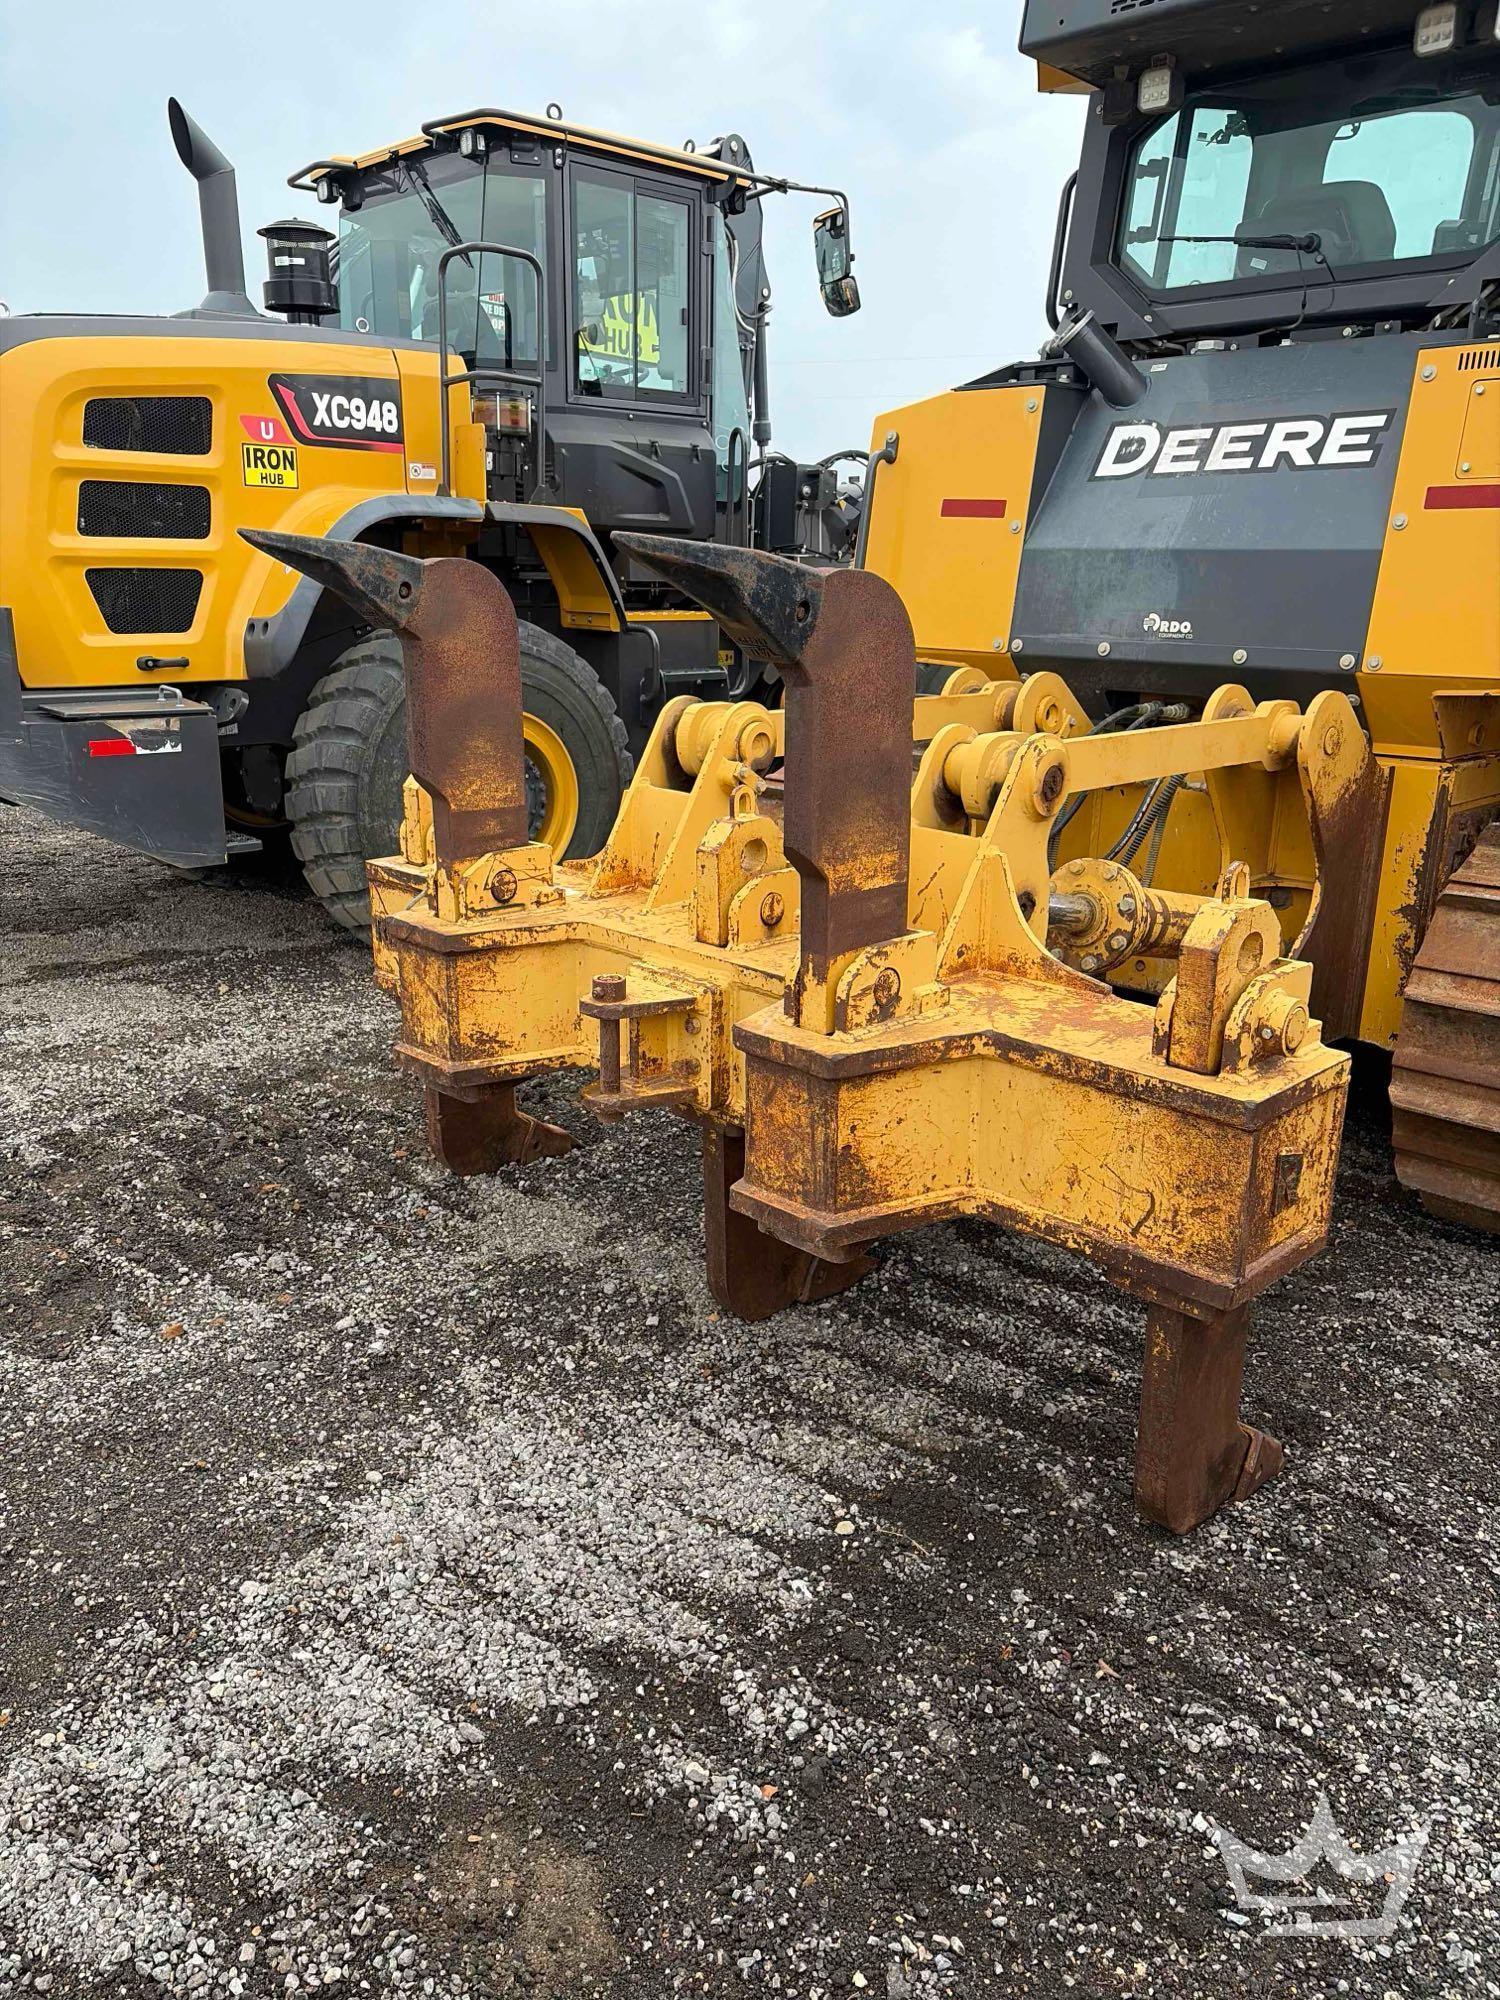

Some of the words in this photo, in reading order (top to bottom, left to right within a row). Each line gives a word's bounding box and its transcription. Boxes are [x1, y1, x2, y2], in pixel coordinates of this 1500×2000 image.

[311, 392, 399, 434] XC948
[260, 421, 274, 440] U
[245, 446, 295, 471] IRON
[1094, 414, 1388, 478] DEERE
[260, 472, 284, 485] HUB
